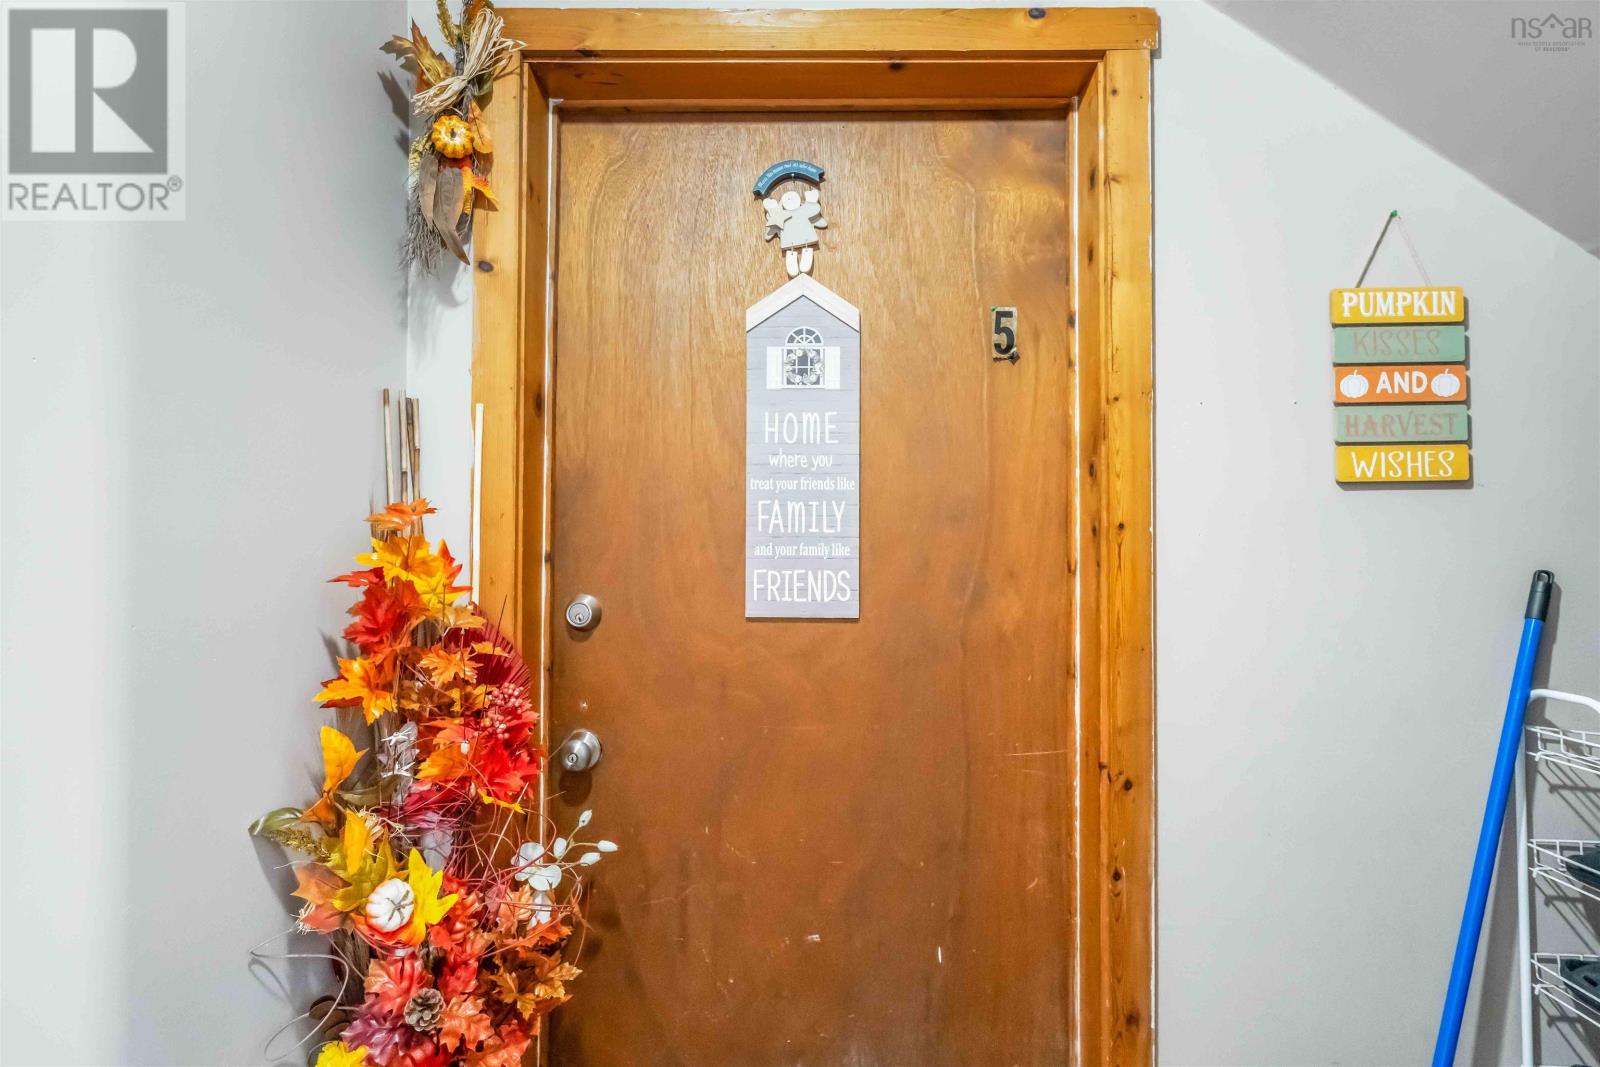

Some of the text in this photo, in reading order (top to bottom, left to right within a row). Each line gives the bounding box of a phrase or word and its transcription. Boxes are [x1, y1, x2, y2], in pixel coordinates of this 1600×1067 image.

[1342, 291, 1456, 318] PUMPKIN
[993, 310, 1015, 355] 5
[1353, 328, 1441, 357] KISSES
[1376, 371, 1428, 395] AND
[764, 411, 839, 445] HOME
[1346, 411, 1459, 437] HARVEST
[768, 448, 833, 471] where you
[1351, 450, 1455, 478] WISHES
[750, 477, 856, 494] treat your friends like
[757, 499, 846, 534] FAMILY
[754, 542, 851, 560] and your family like
[753, 569, 852, 603] FRIENDS
